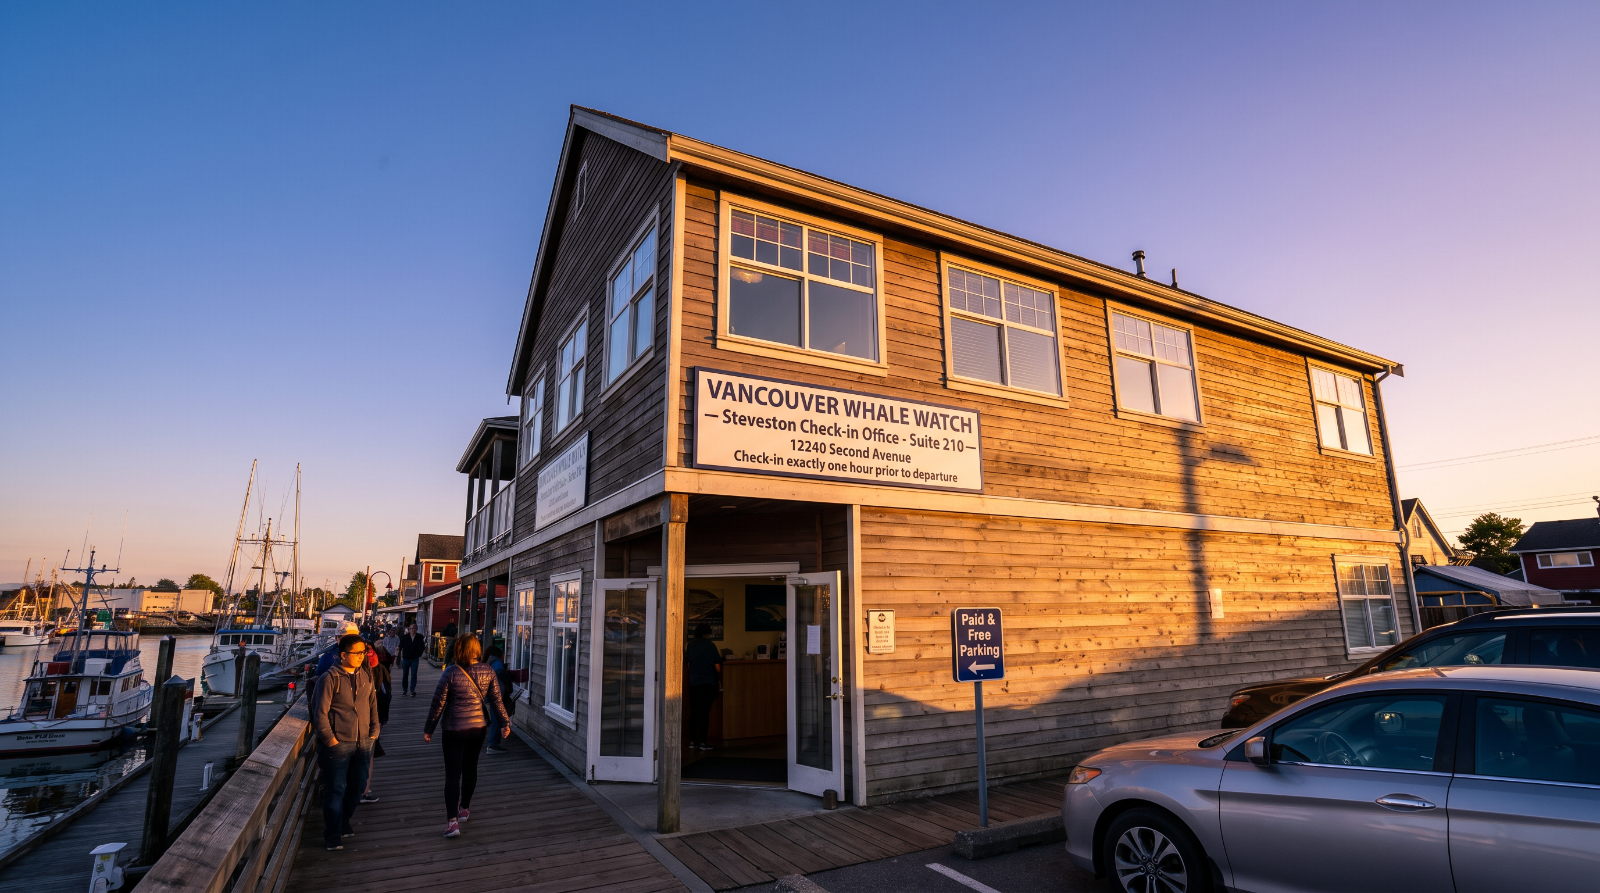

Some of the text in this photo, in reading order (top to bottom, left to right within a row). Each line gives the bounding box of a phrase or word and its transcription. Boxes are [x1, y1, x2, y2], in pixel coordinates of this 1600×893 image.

[706, 378, 972, 434] VANCOUVER WHALE WATCH
[722, 408, 796, 432] Steveston
[799, 418, 859, 440] Check-in
[862, 426, 899, 444] Office
[909, 433, 940, 450] Suite
[942, 437, 964, 453] 210
[790, 438, 912, 464] 12240 Second Avenue
[733, 449, 958, 483] Check-in exactly one hour prior to departure
[961, 613, 996, 626] Paid &
[968, 628, 992, 641] Free
[960, 643, 1000, 659] Parking
